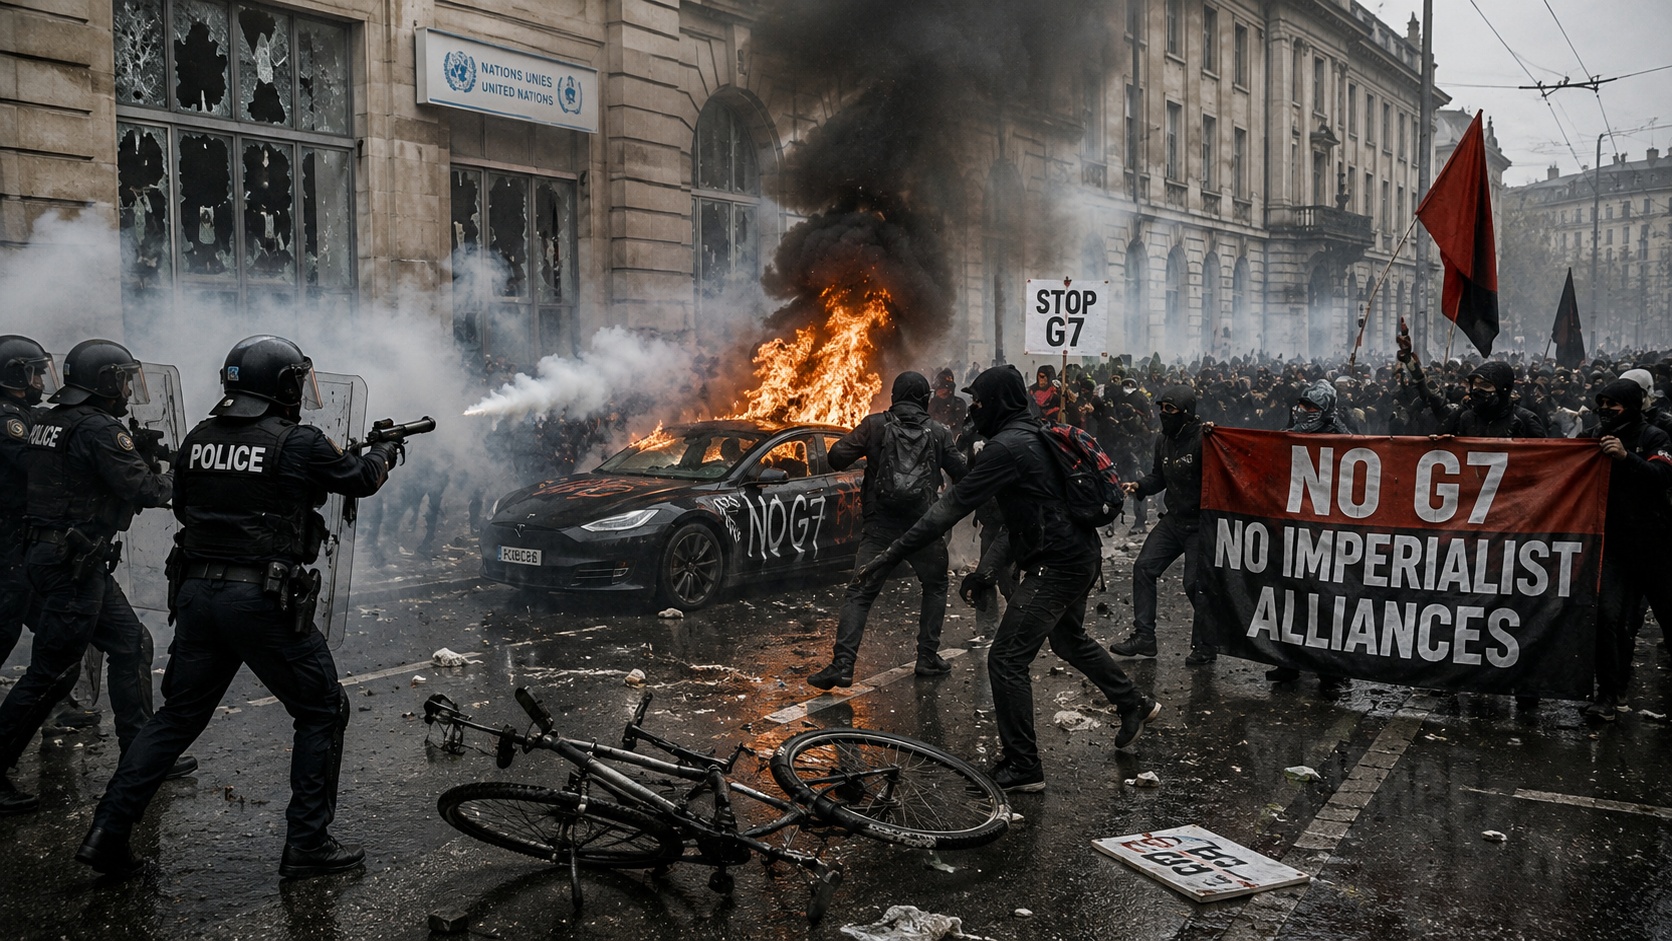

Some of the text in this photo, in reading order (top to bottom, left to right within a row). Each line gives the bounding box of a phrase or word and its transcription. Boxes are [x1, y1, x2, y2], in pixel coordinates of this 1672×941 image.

[481, 61, 553, 88] NATIONS UNIES
[481, 81, 554, 106] UNITED NATIONS
[1036, 289, 1097, 315] STOP
[1046, 316, 1085, 347] G7
[189, 443, 266, 473] POLICE
[1286, 444, 1509, 524] NO G7
[1214, 517, 1582, 598] NO IMPERIALIST
[1246, 586, 1521, 669] ALLIANCES
